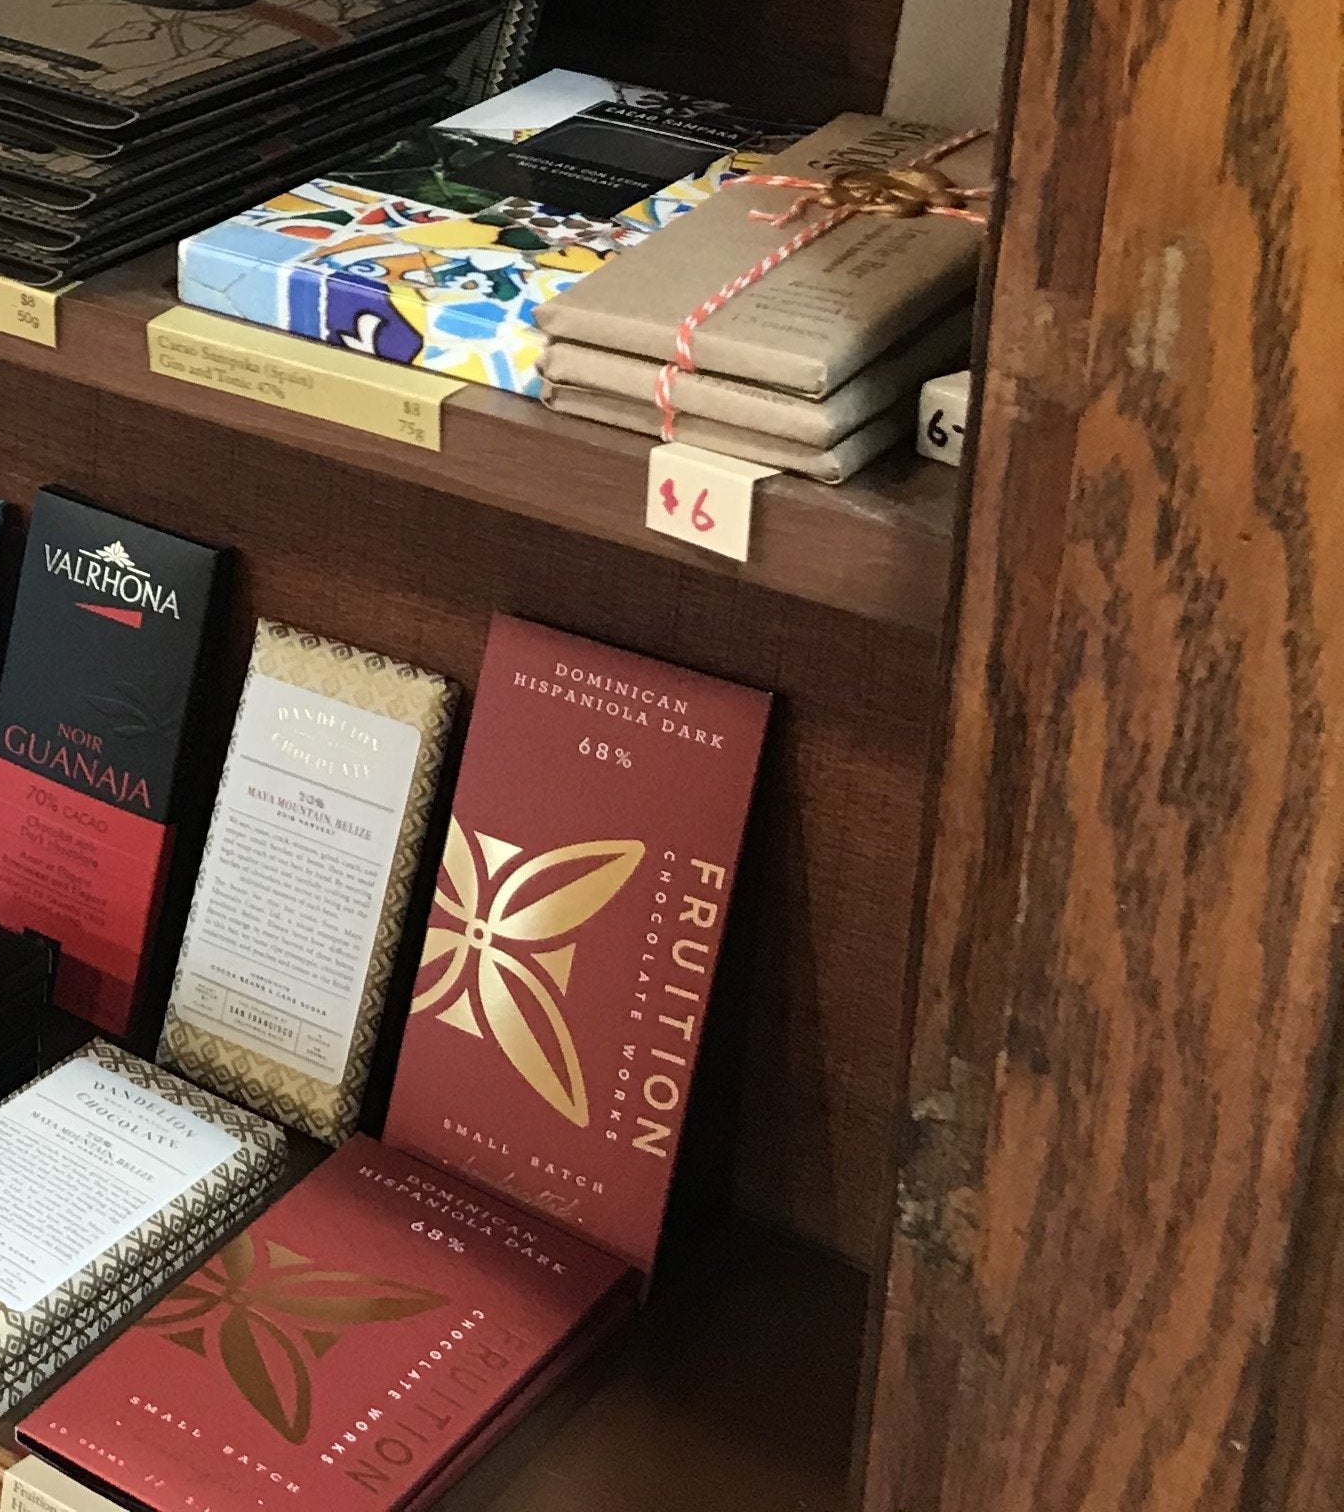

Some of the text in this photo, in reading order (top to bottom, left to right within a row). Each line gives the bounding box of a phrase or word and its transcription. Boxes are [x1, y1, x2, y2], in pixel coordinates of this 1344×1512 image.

[604, 104, 659, 123] CACAO
[16, 309, 41, 330] 50g
[19, 292, 37, 309] $8
[157, 334, 198, 358] Cacao
[200, 345, 261, 374] Sampaka
[43, 543, 181, 621] VALRHONA
[513, 672, 726, 750] HISPANIOLA DARK
[554, 662, 690, 716] DOMINICAN
[2, 723, 153, 810] GUANAJA
[56, 720, 105, 755] NOIR
[578, 736, 633, 770] 68%
[605, 849, 676, 1142] CHOCOLATE WORKS
[631, 856, 727, 1159] FRUITION
[75, 1091, 180, 1151] CHOCOLATE
[92, 1079, 196, 1139] DANDELION
[442, 1117, 604, 1195] SMALL BATCH
[358, 1165, 567, 1275] HISPANIOLA DARK
[405, 1173, 538, 1243] DOMINICAN
[409, 1220, 466, 1254] 68%
[319, 1308, 486, 1466] CHOCOLATE WORKS
[128, 1395, 302, 1494] SMALL BATCH
